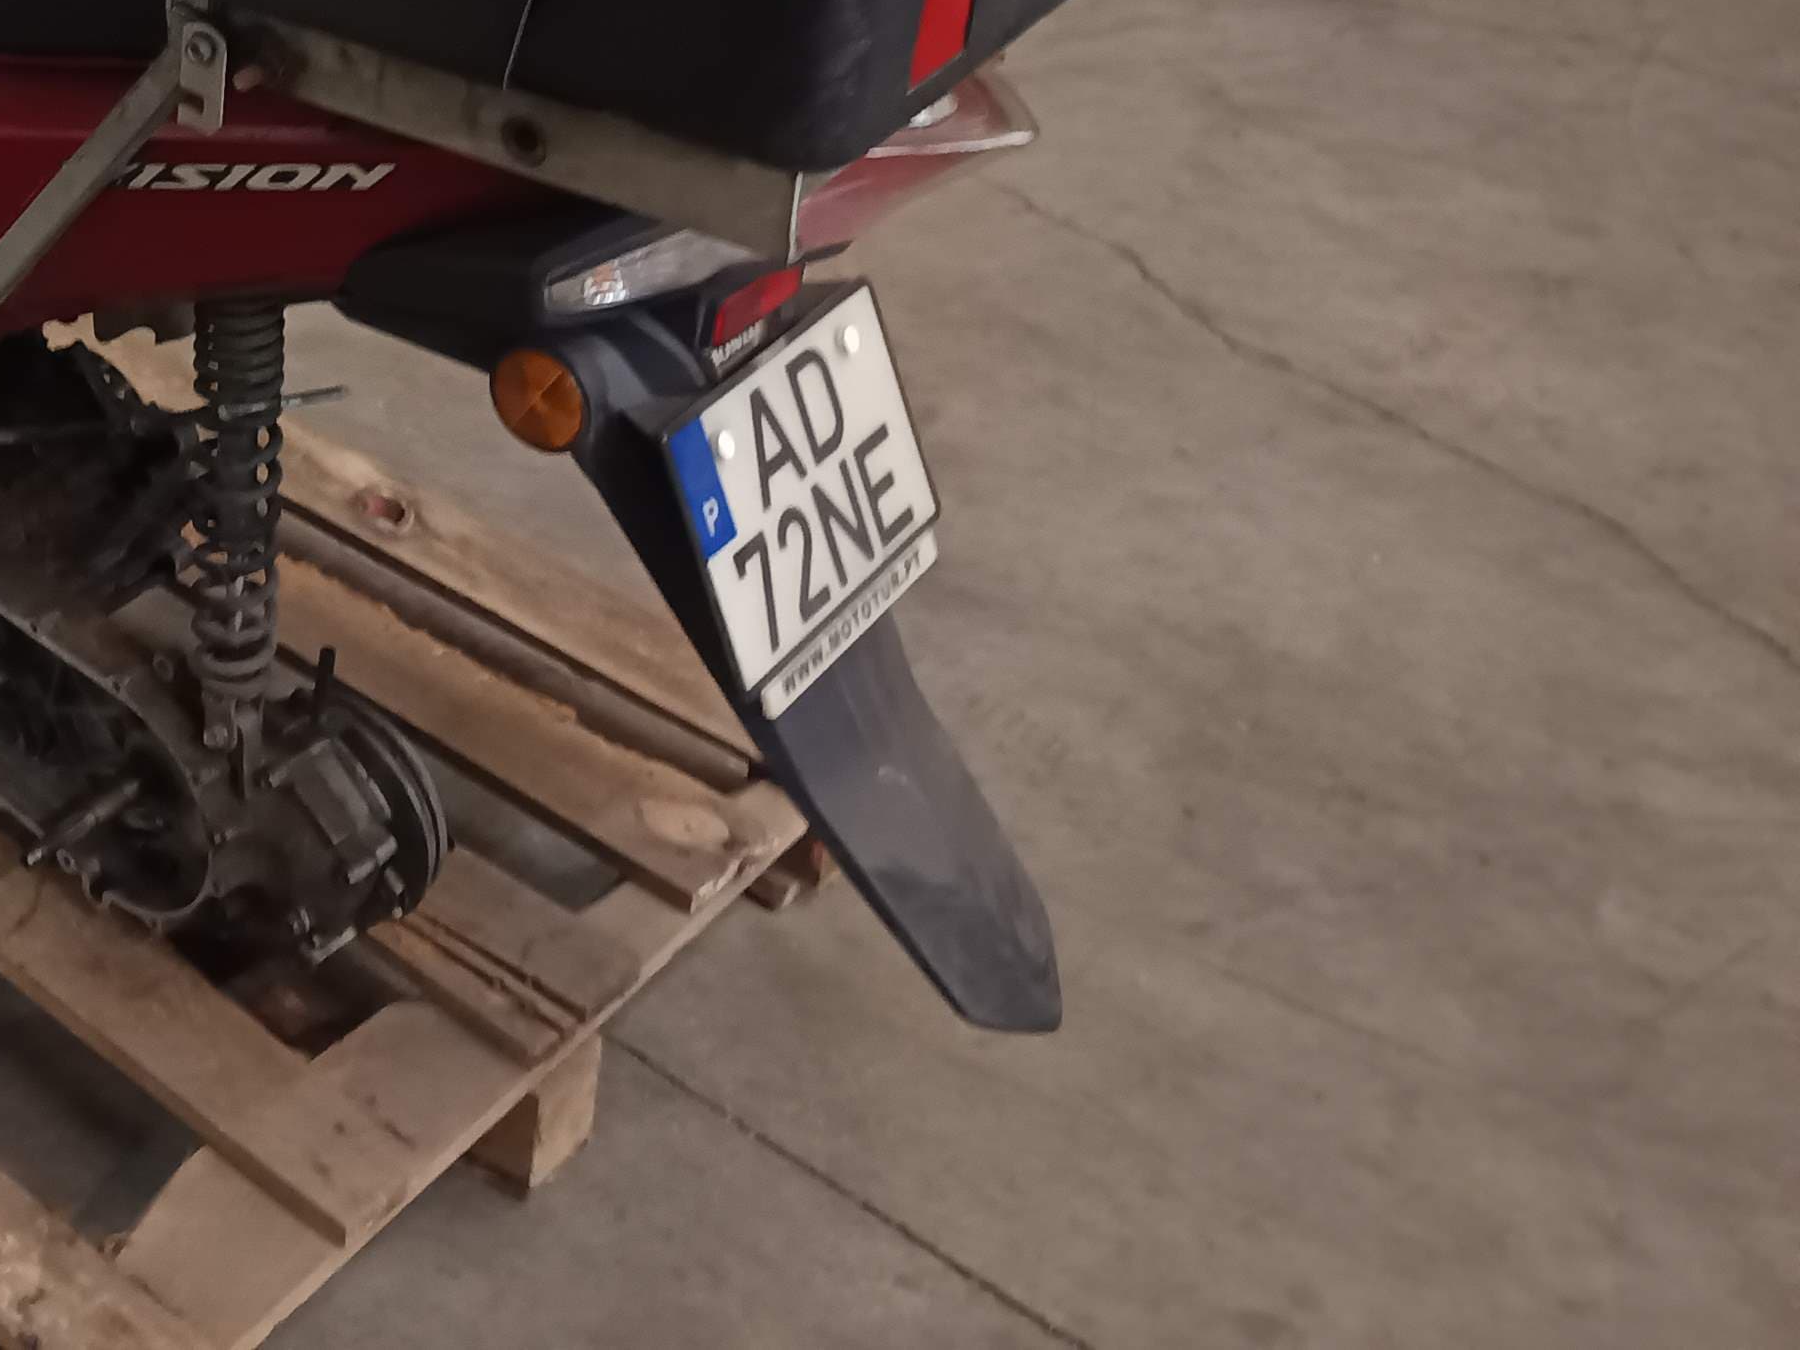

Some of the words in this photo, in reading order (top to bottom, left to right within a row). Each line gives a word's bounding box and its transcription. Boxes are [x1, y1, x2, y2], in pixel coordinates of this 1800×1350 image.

[114, 162, 397, 191] ISION
[748, 349, 846, 513] AD
[733, 423, 915, 656] 72NE
